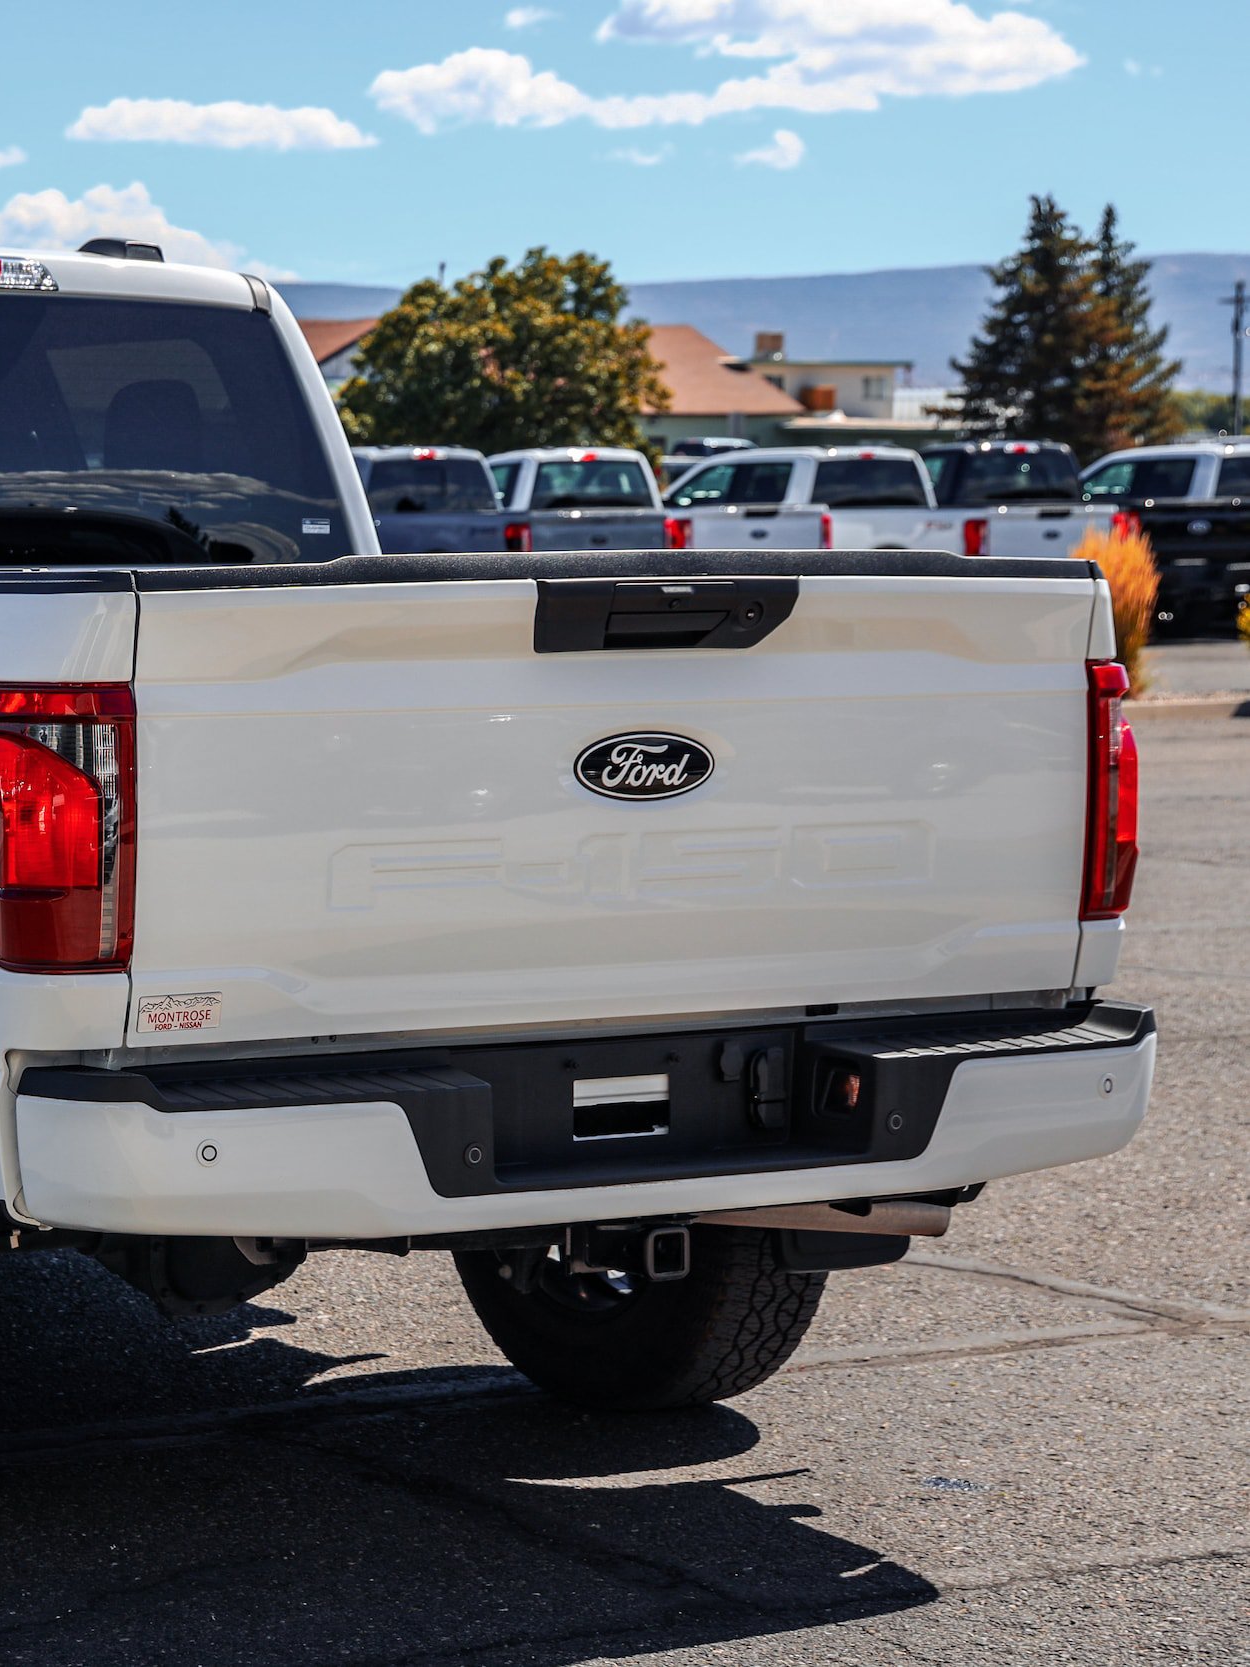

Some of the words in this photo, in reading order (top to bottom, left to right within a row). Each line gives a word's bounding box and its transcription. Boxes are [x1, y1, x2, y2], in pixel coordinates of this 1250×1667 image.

[601, 743, 690, 788] Ford
[147, 1009, 212, 1024] MONTROSE
[154, 1022, 173, 1031] FORD
[179, 1021, 203, 1030] NISSAN
